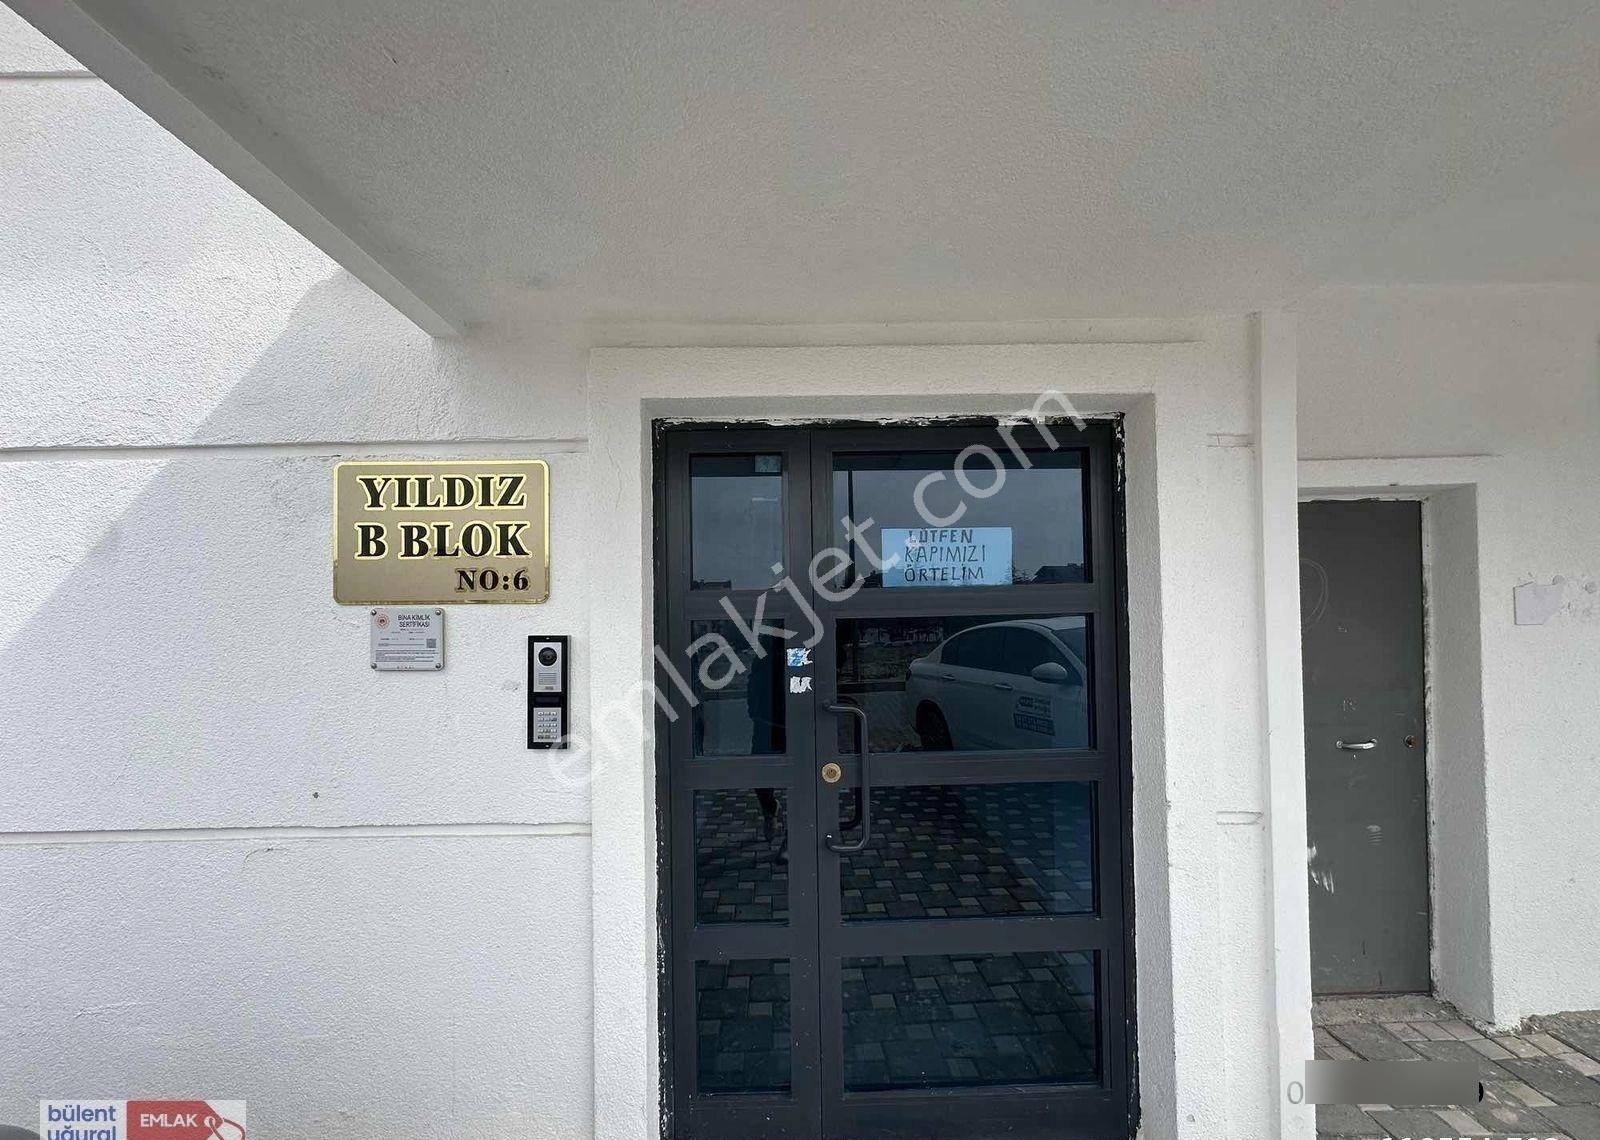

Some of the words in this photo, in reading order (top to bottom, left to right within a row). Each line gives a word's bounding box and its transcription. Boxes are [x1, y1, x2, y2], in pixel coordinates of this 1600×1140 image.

[357, 474, 528, 510] YILDIZ
[355, 522, 389, 559] B
[398, 521, 532, 559] BLOK
[905, 545, 986, 562] KAPIMIZI
[456, 568, 529, 591] NO:6
